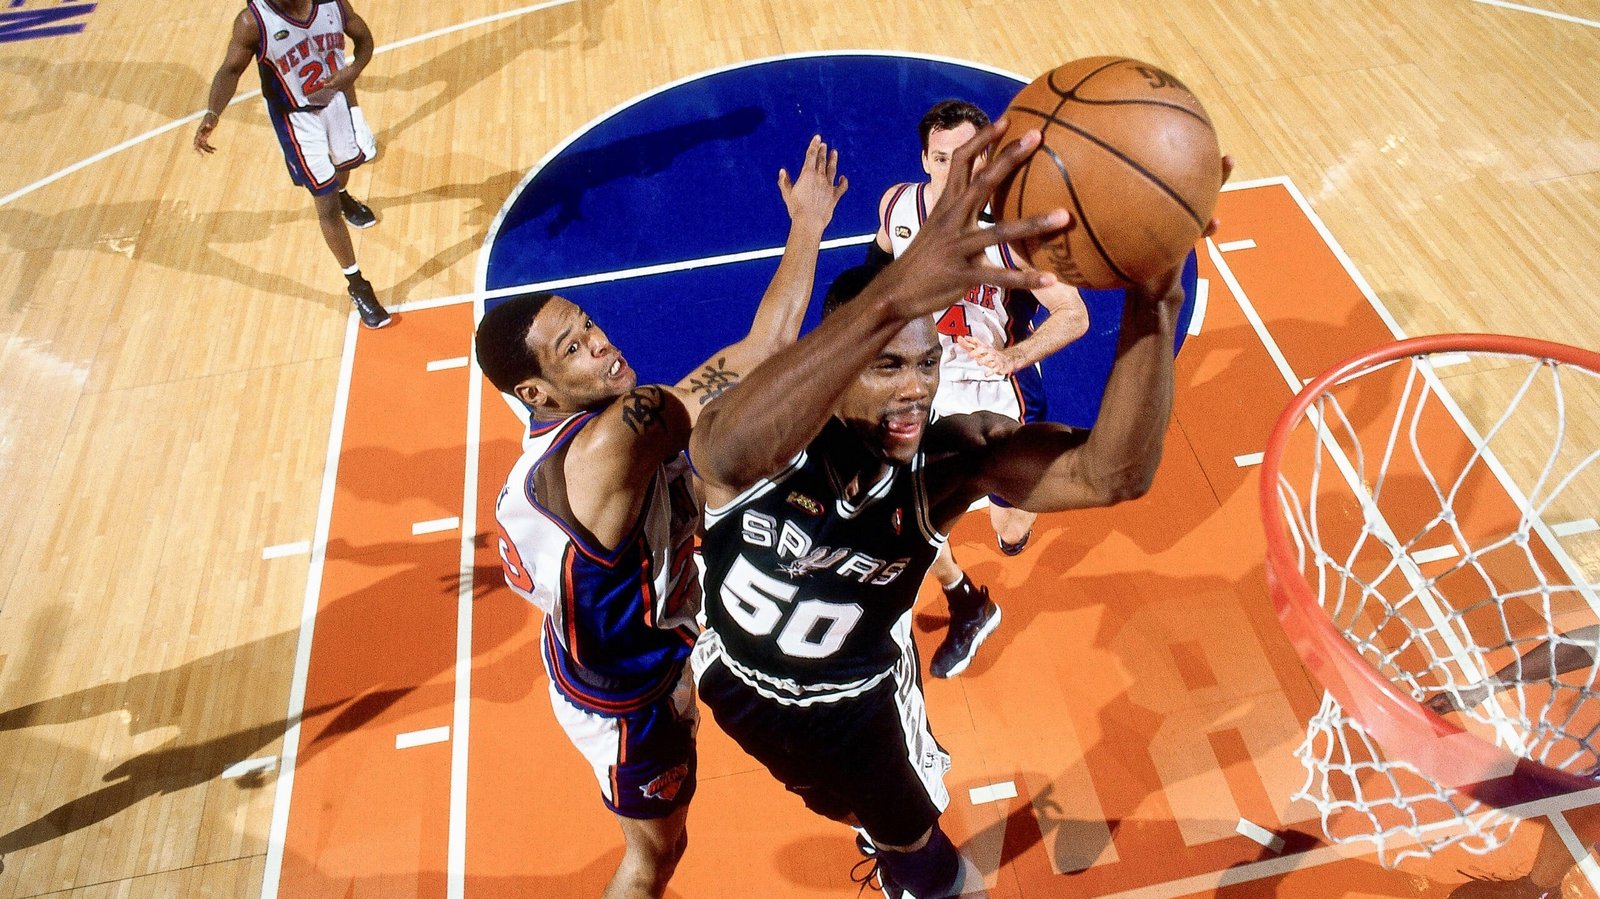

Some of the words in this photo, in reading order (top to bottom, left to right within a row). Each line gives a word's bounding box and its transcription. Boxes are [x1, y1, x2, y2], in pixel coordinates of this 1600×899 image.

[276, 36, 310, 75] NEW
[299, 50, 338, 96] 21
[936, 305, 972, 343] 4
[499, 526, 535, 594] 3
[742, 509, 911, 585] SPURS
[720, 553, 864, 659] 50
